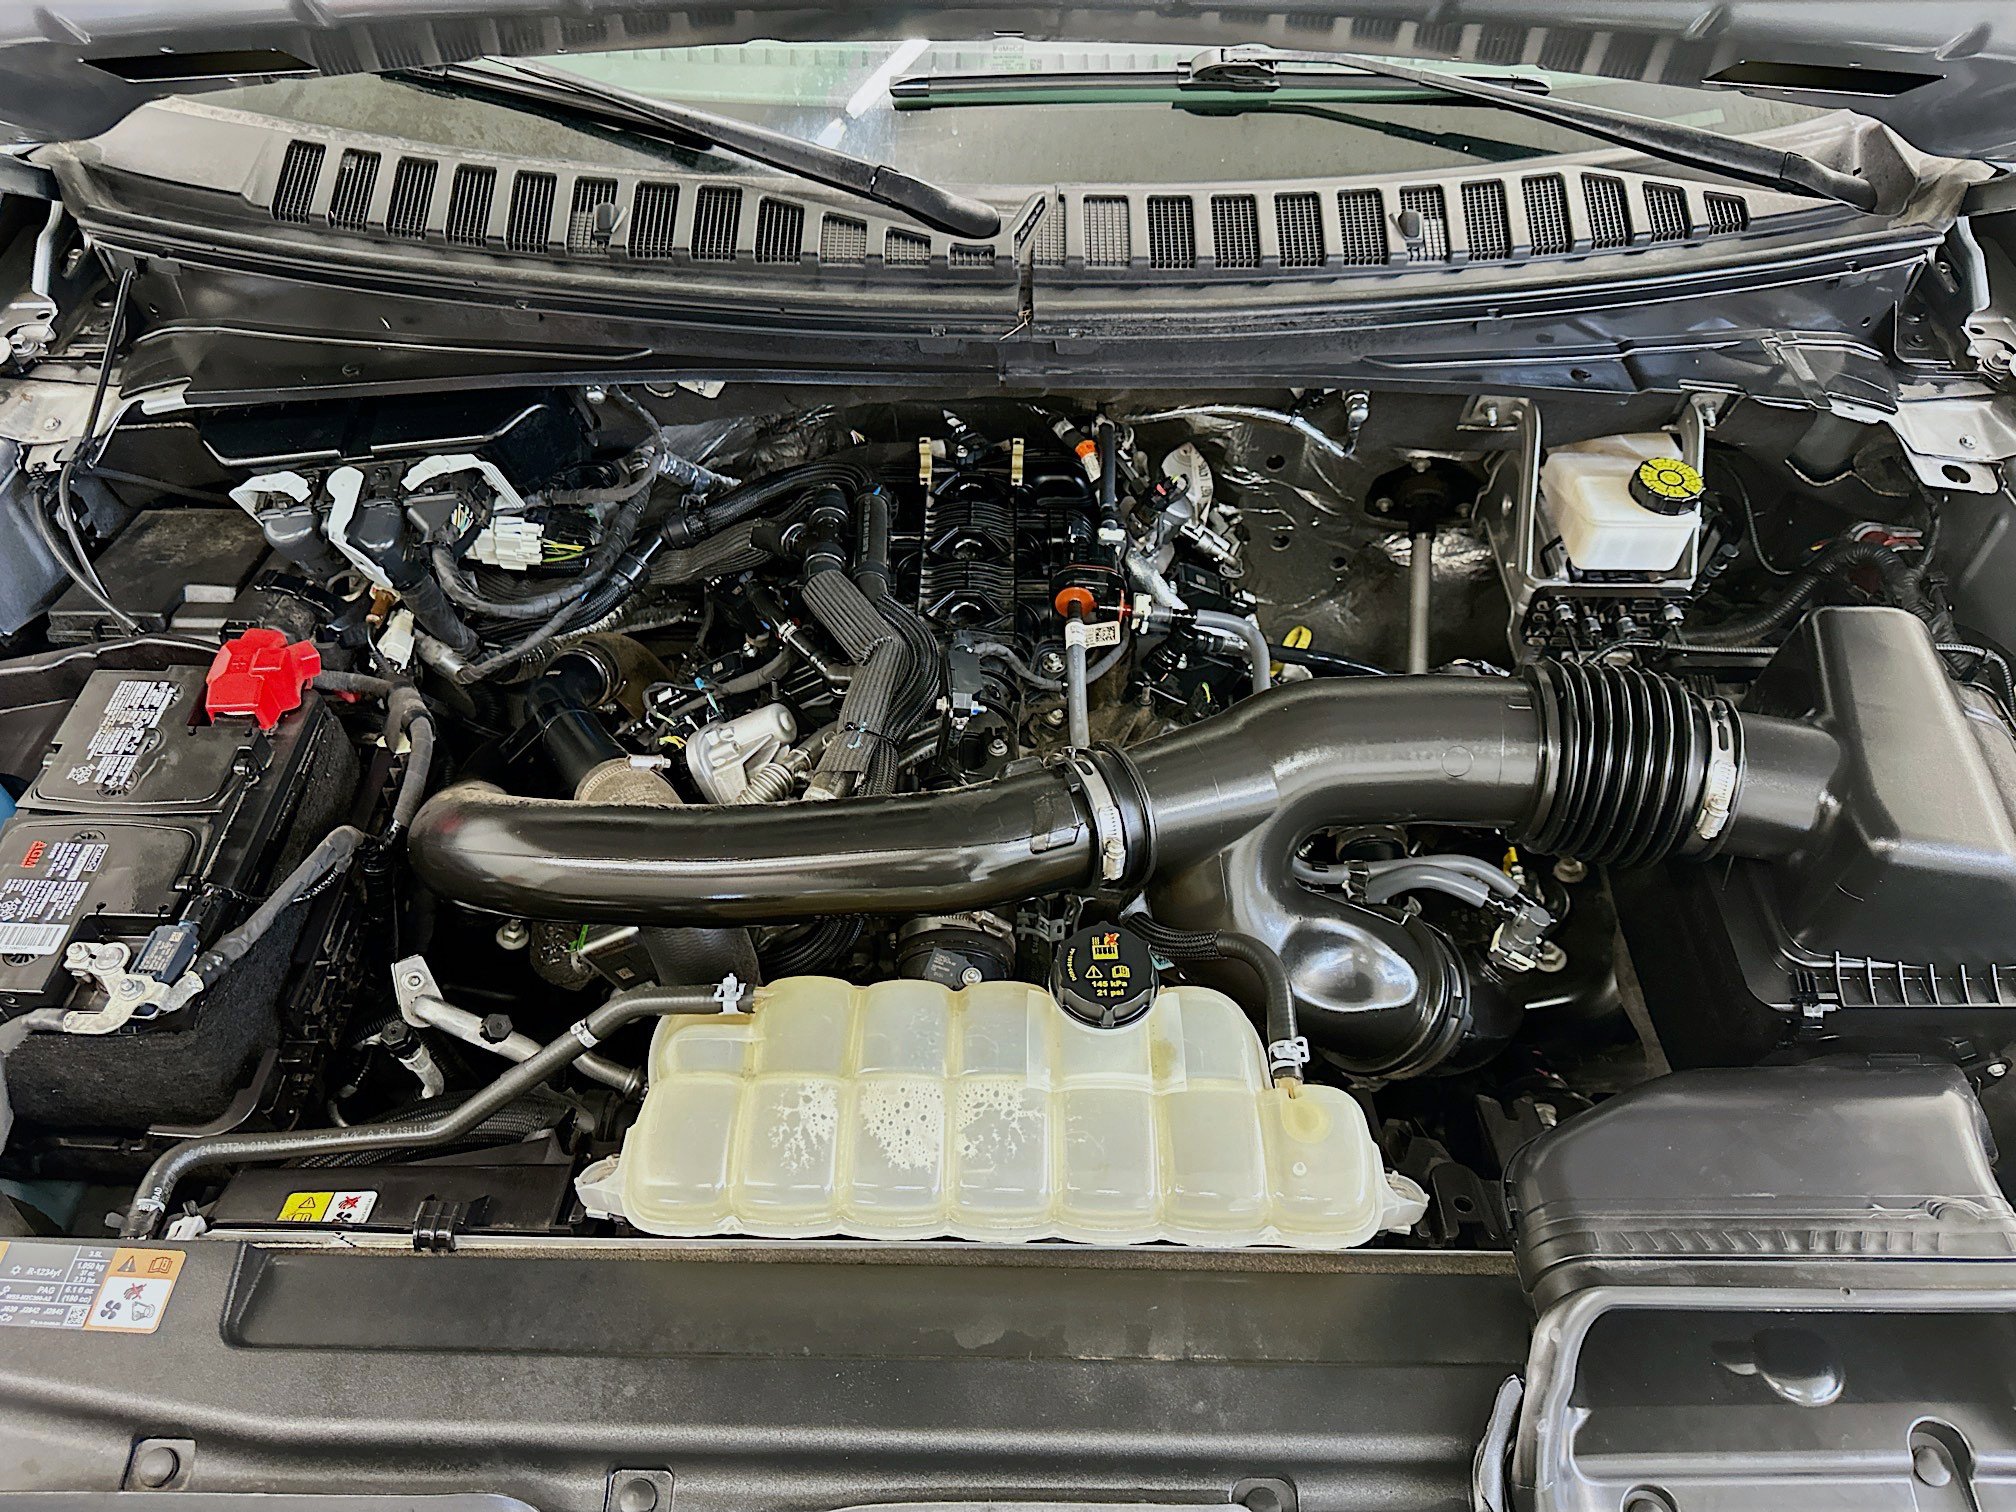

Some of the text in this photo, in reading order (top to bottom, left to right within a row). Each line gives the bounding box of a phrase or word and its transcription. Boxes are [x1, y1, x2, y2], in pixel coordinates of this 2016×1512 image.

[1110, 988, 1124, 998] psi
[95, 1262, 106, 1272] kg
[26, 1267, 62, 1278] R-1234yf
[37, 1286, 55, 1294] PAG
[65, 1285, 76, 1294] 6.1
[61, 1294, 92, 1305] (180 cc)
